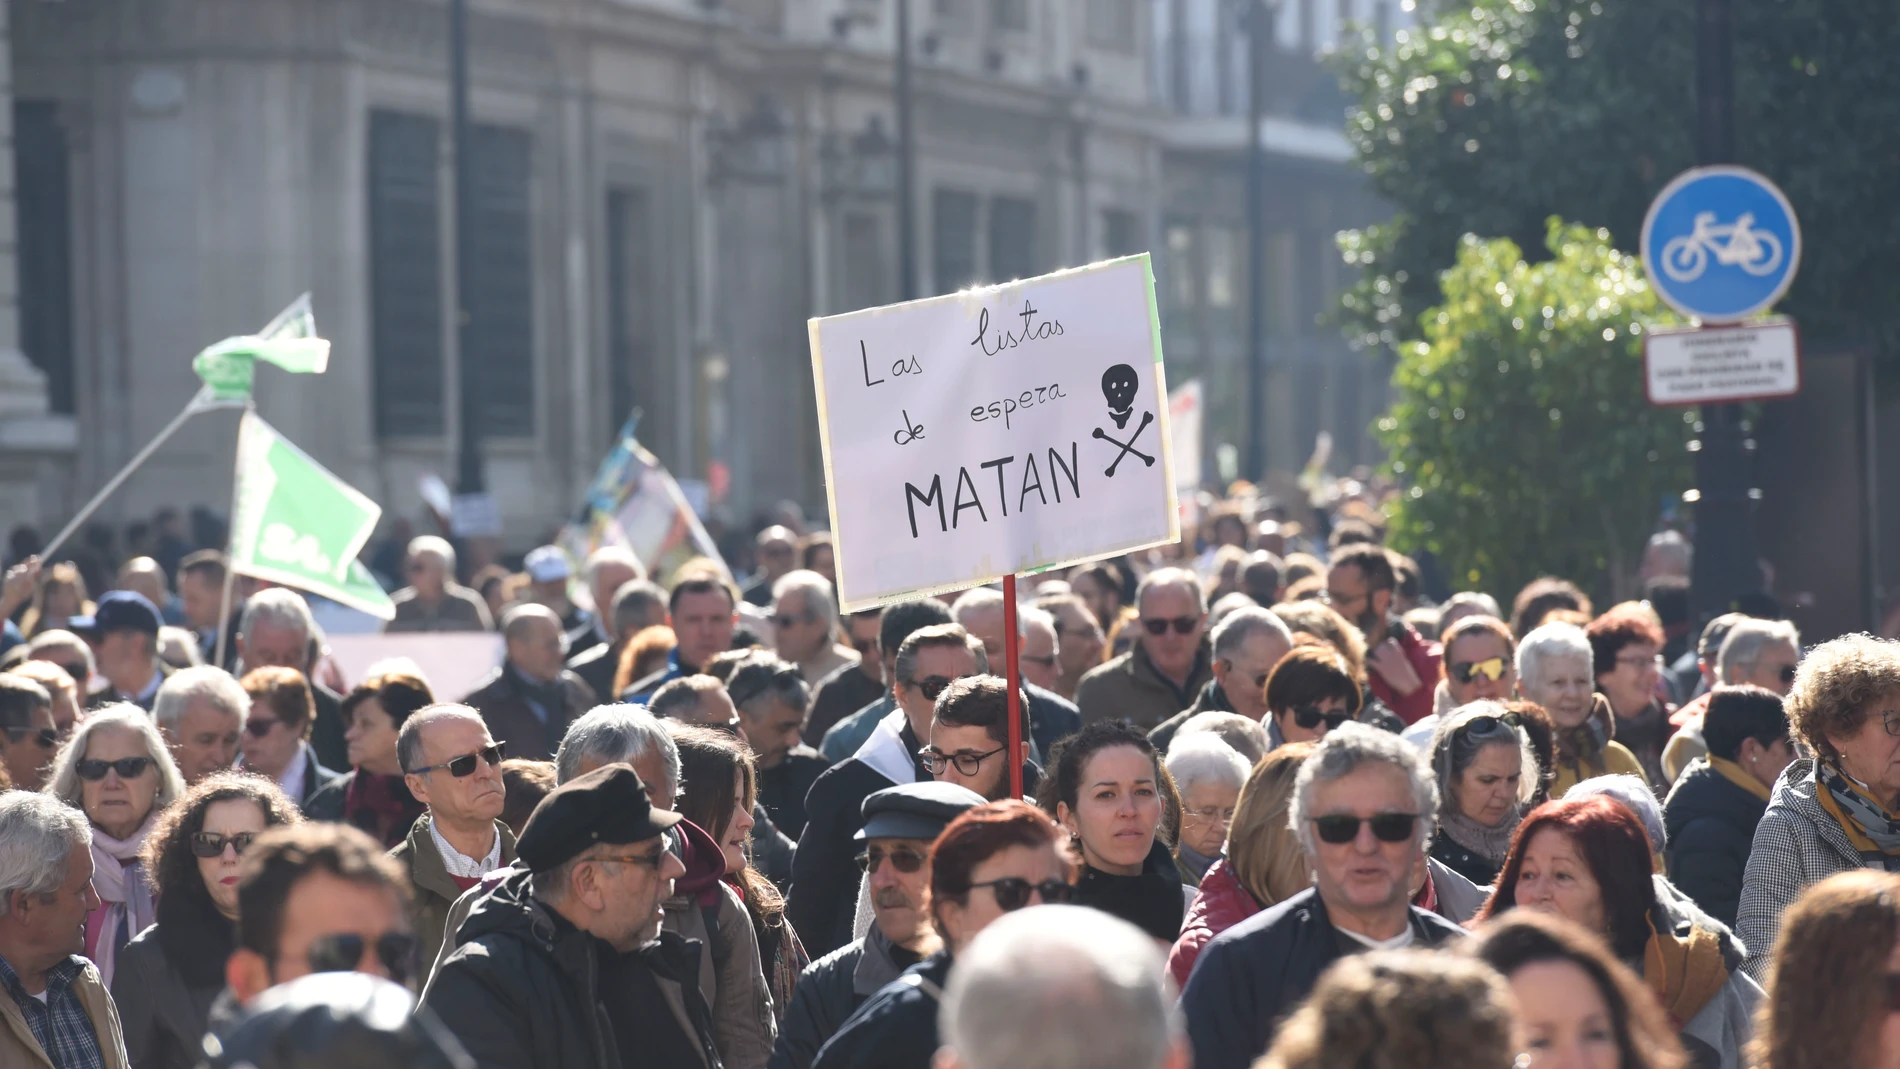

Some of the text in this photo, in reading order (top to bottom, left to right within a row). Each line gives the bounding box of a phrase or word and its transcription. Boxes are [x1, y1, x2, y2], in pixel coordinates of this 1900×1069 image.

[860, 299, 1065, 387] Las listas
[893, 382, 1067, 446] de espera
[904, 441, 1081, 539] MATAN
